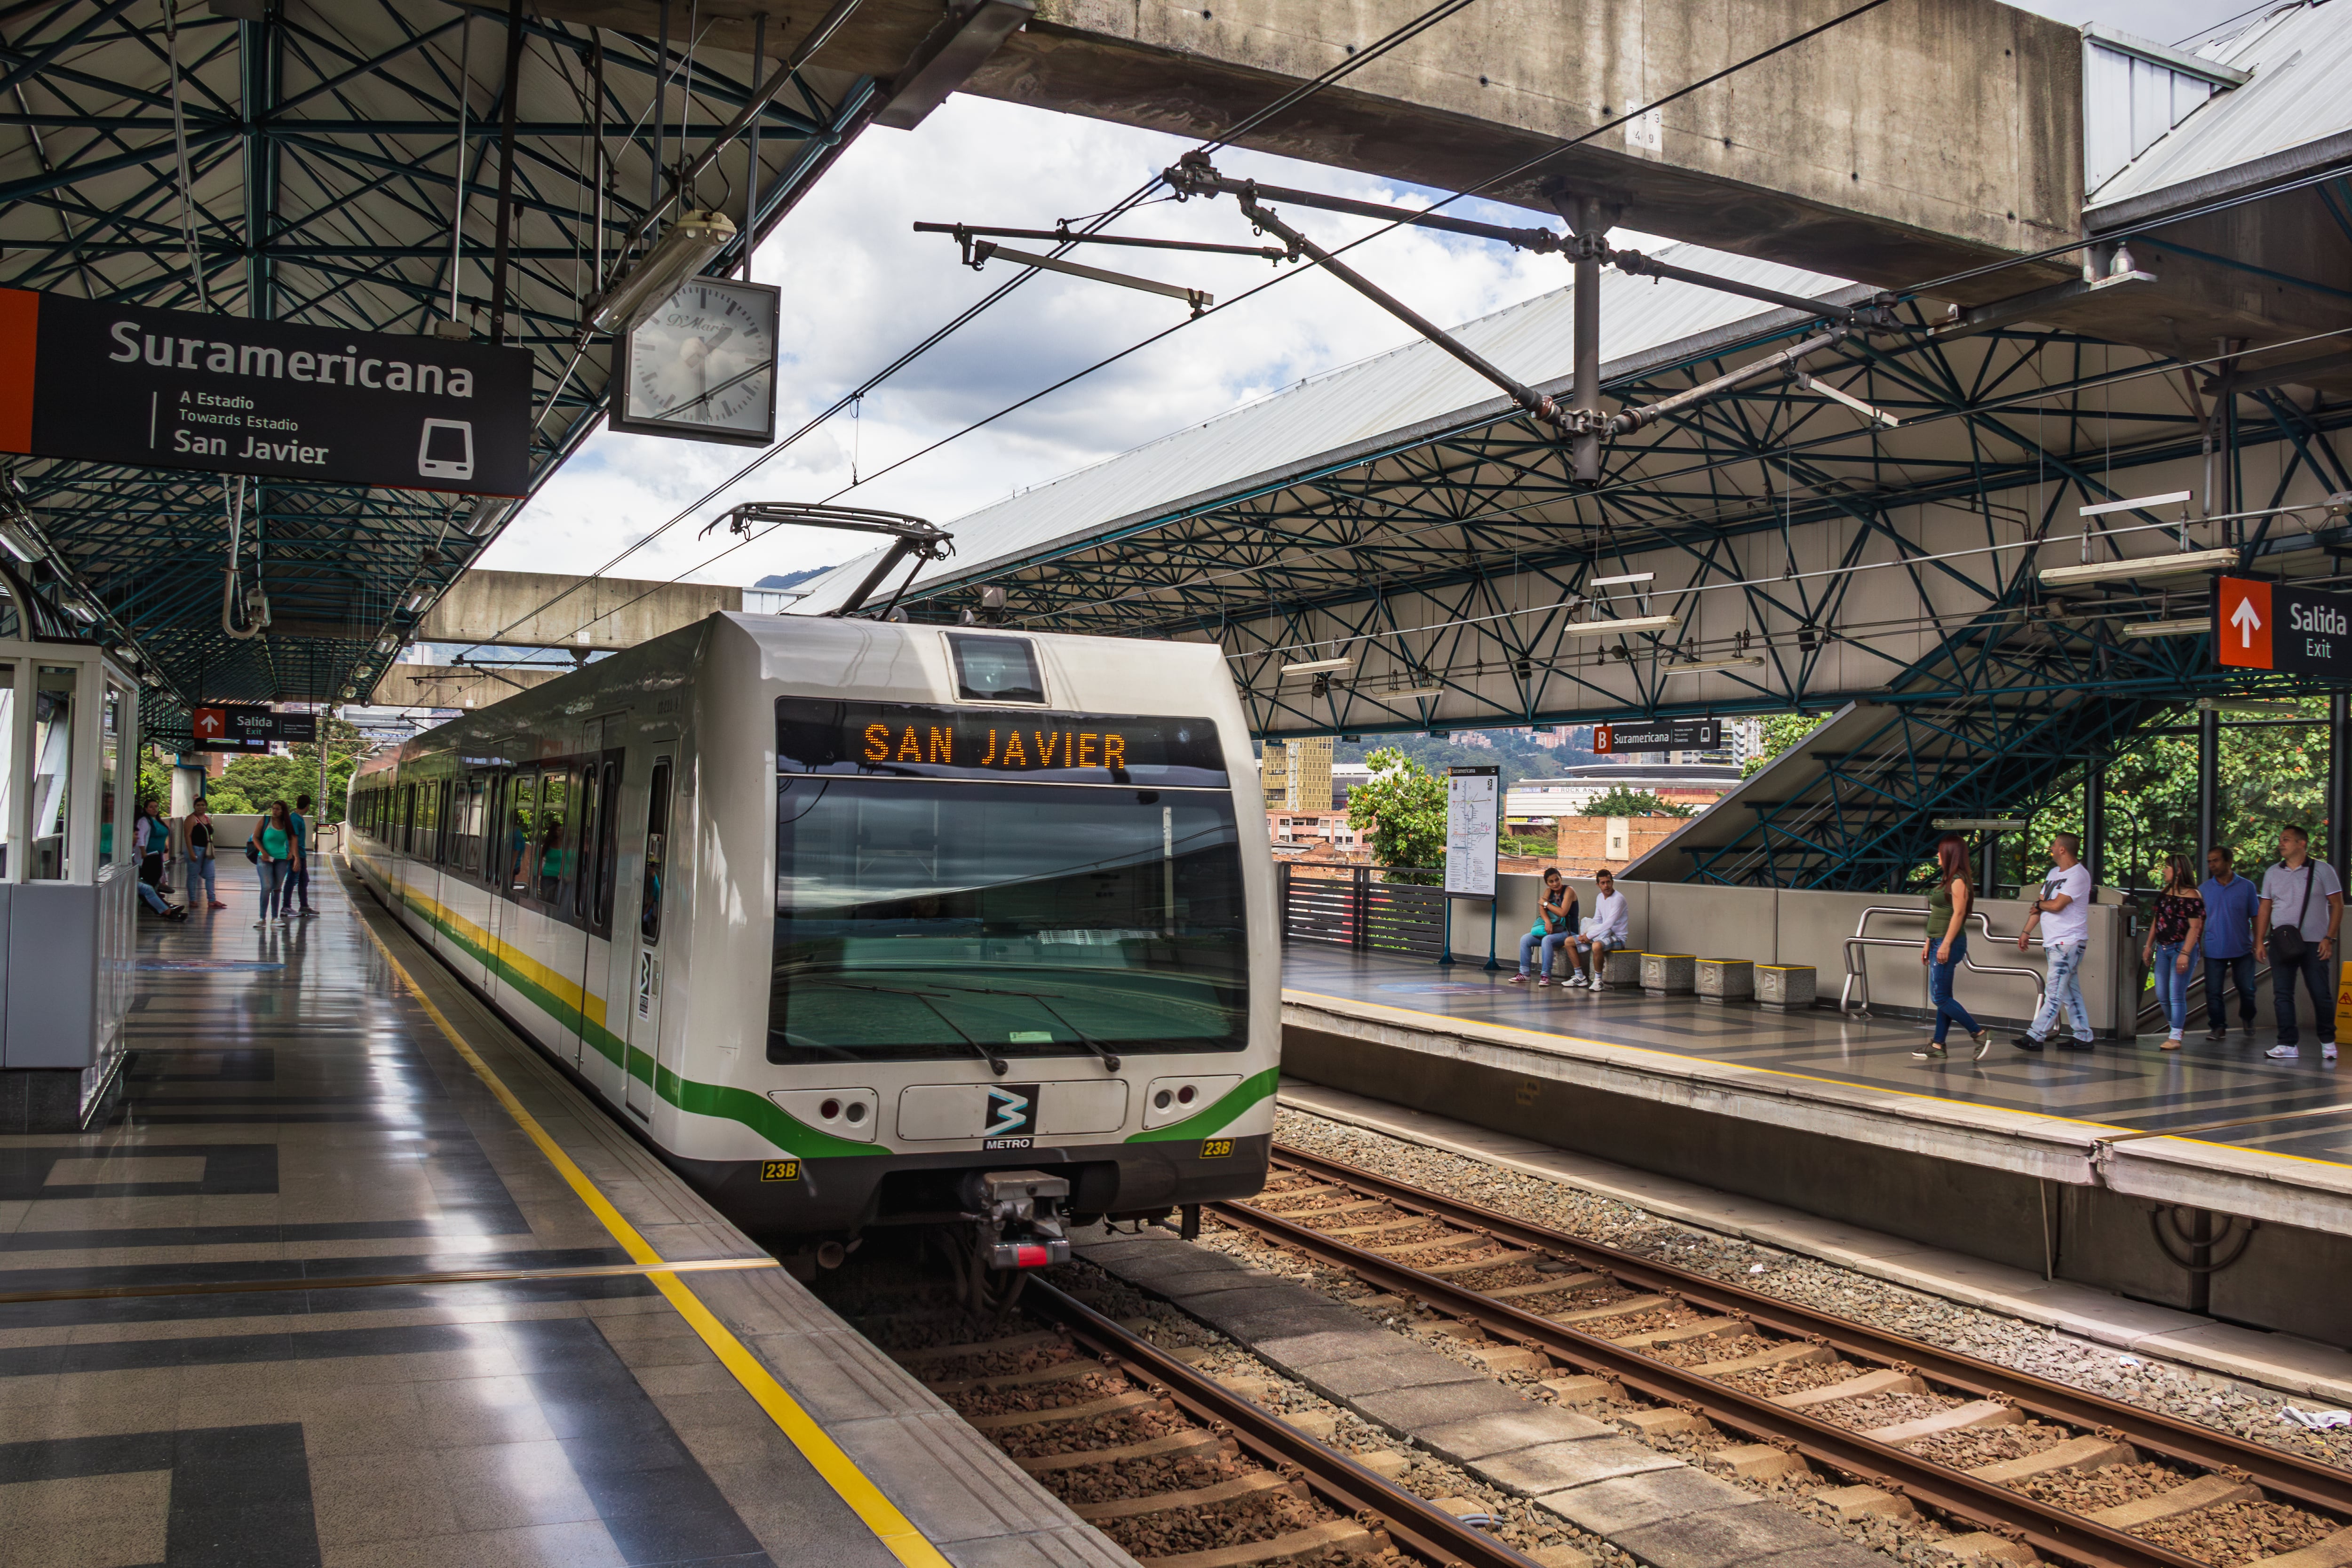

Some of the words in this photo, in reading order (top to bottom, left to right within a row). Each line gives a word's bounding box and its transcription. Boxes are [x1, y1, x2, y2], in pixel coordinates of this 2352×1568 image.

[109, 321, 473, 398] Suramericana
[180, 391, 191, 403] A
[198, 392, 254, 409] Estadio
[179, 409, 241, 426] Towards
[247, 415, 298, 431] Estadio
[174, 430, 227, 455] San
[238, 436, 329, 465] Javier
[2290, 603, 2346, 636] Salida
[2306, 638, 2332, 659] Exit
[237, 716, 272, 727] Salida
[864, 724, 952, 763] SAN
[981, 729, 1125, 769] JAVIER
[1598, 731, 1607, 749] B
[1614, 732, 1669, 744] Suramericana
[986, 1139, 1030, 1149] METRO
[1204, 1141, 1231, 1155] 23B
[766, 1162, 796, 1178] 23B
